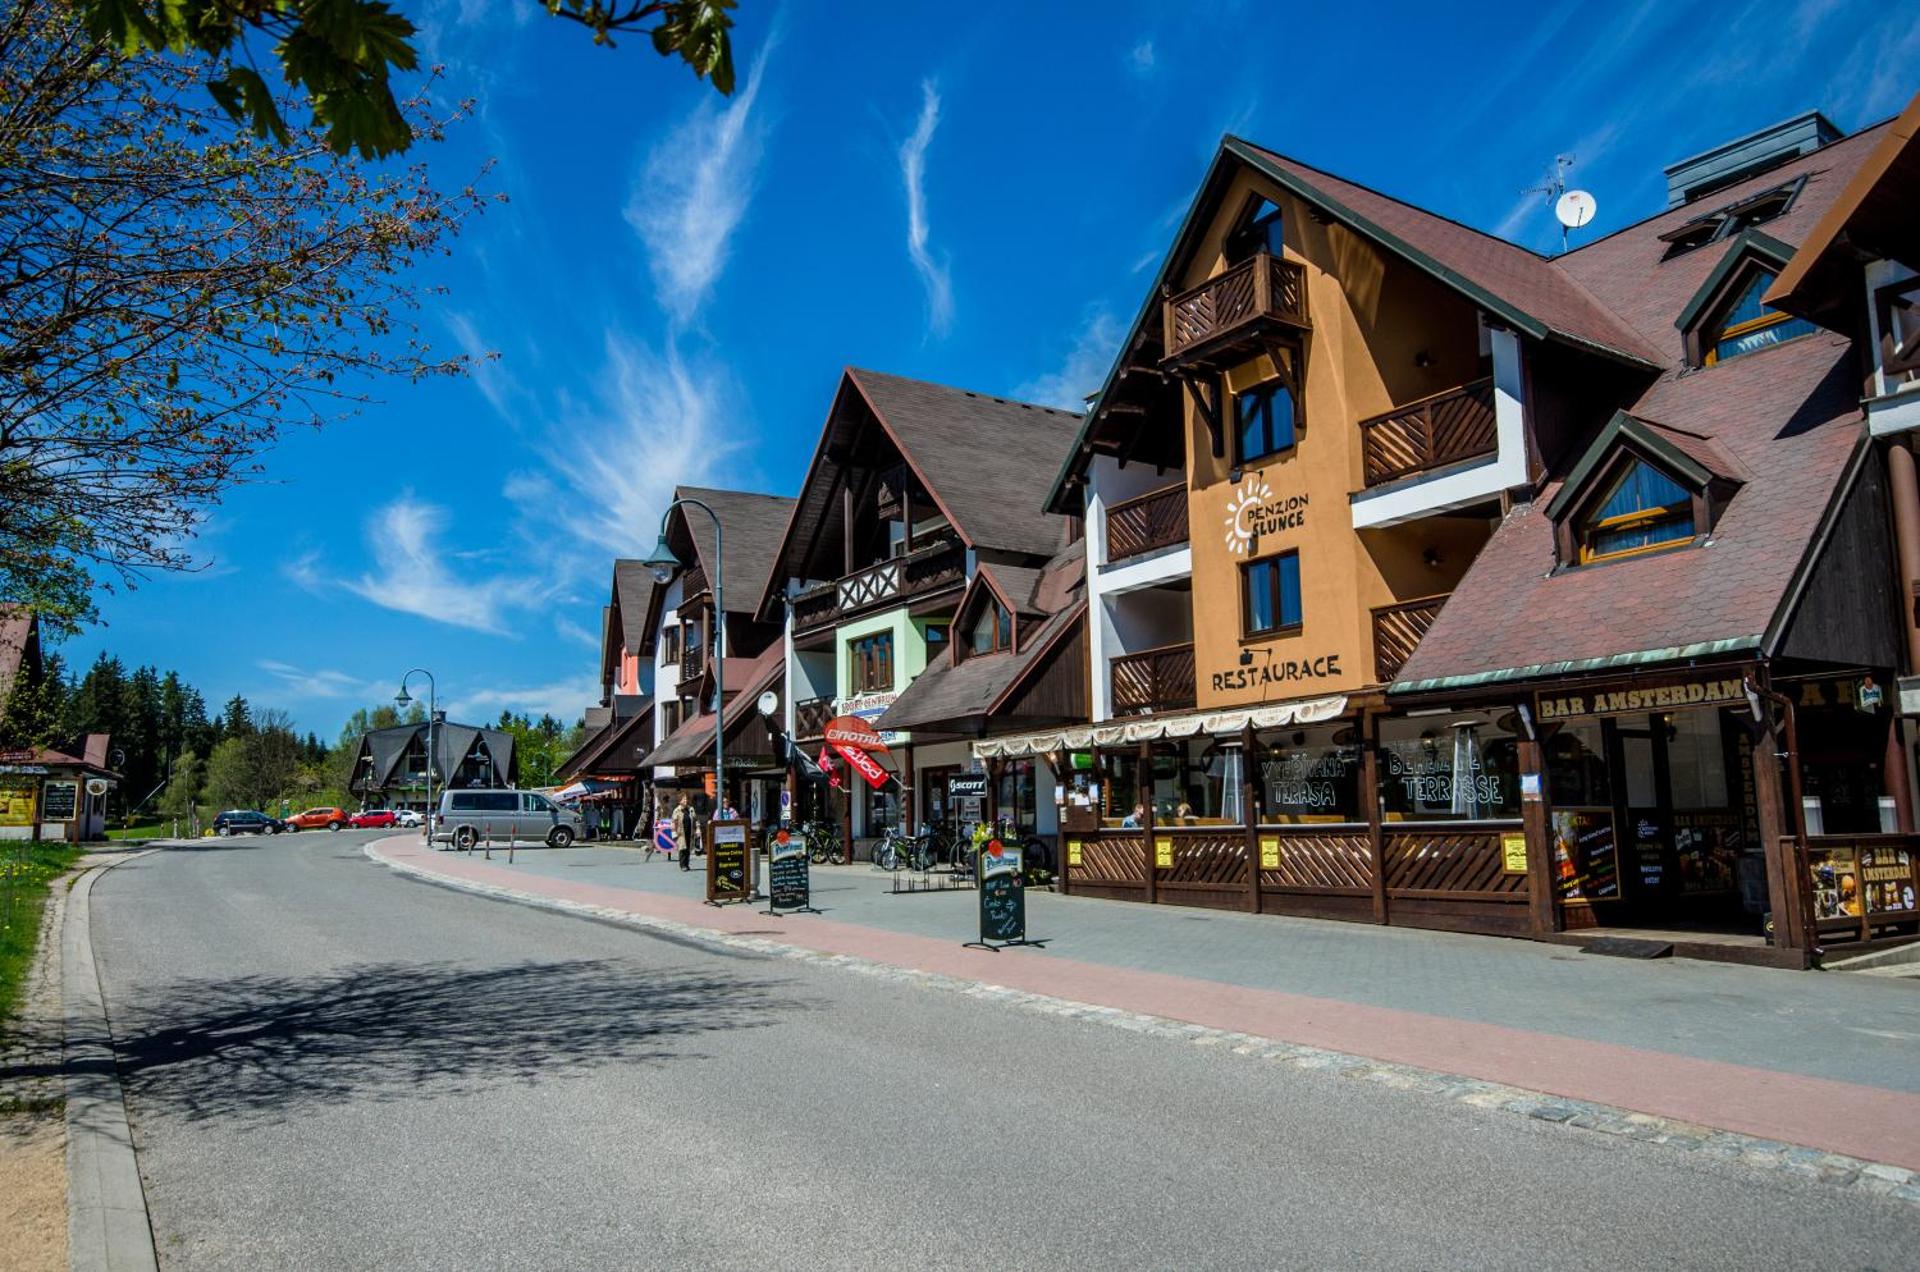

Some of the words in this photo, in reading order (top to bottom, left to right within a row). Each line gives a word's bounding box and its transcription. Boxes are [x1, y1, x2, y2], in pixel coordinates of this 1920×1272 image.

[1248, 494, 1309, 523] PENZION
[1252, 510, 1304, 538] SLUNCE
[1213, 655, 1342, 691] RESTAURACE
[1541, 698, 1585, 718] BAR
[1593, 679, 1743, 712] AMSTERDAM
[1272, 781, 1336, 807] TERASA
[1401, 774, 1504, 804] TERRASSE
[1875, 848, 1896, 865] BAR
[1863, 866, 1911, 881] AMSTERDAM
